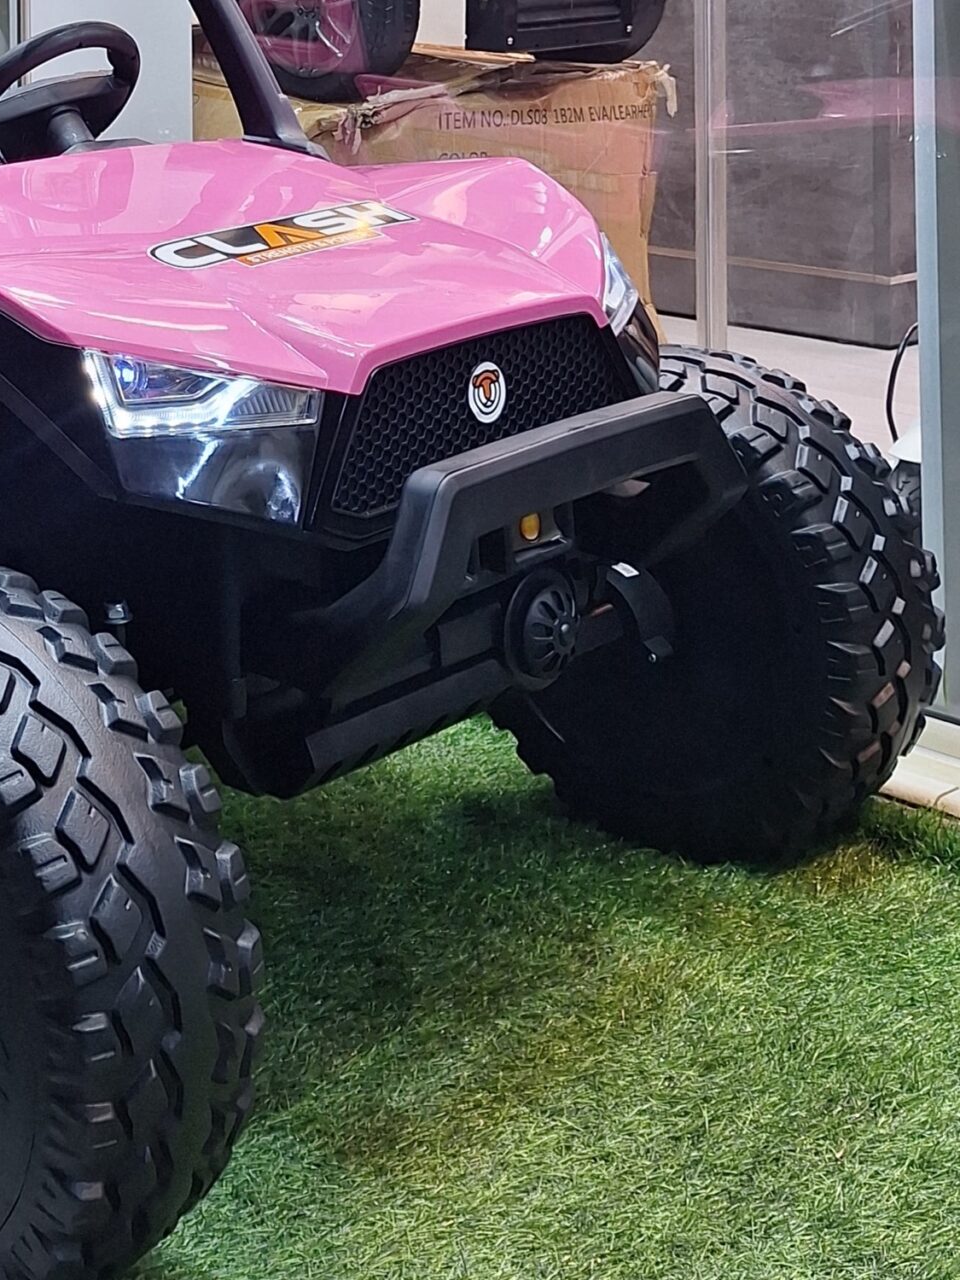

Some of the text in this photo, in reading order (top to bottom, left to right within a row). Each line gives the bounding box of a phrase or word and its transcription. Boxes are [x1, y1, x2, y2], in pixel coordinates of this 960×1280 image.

[439, 110, 476, 130] ITEM
[554, 107, 585, 125] 1B2M
[153, 200, 414, 269] CLASH
